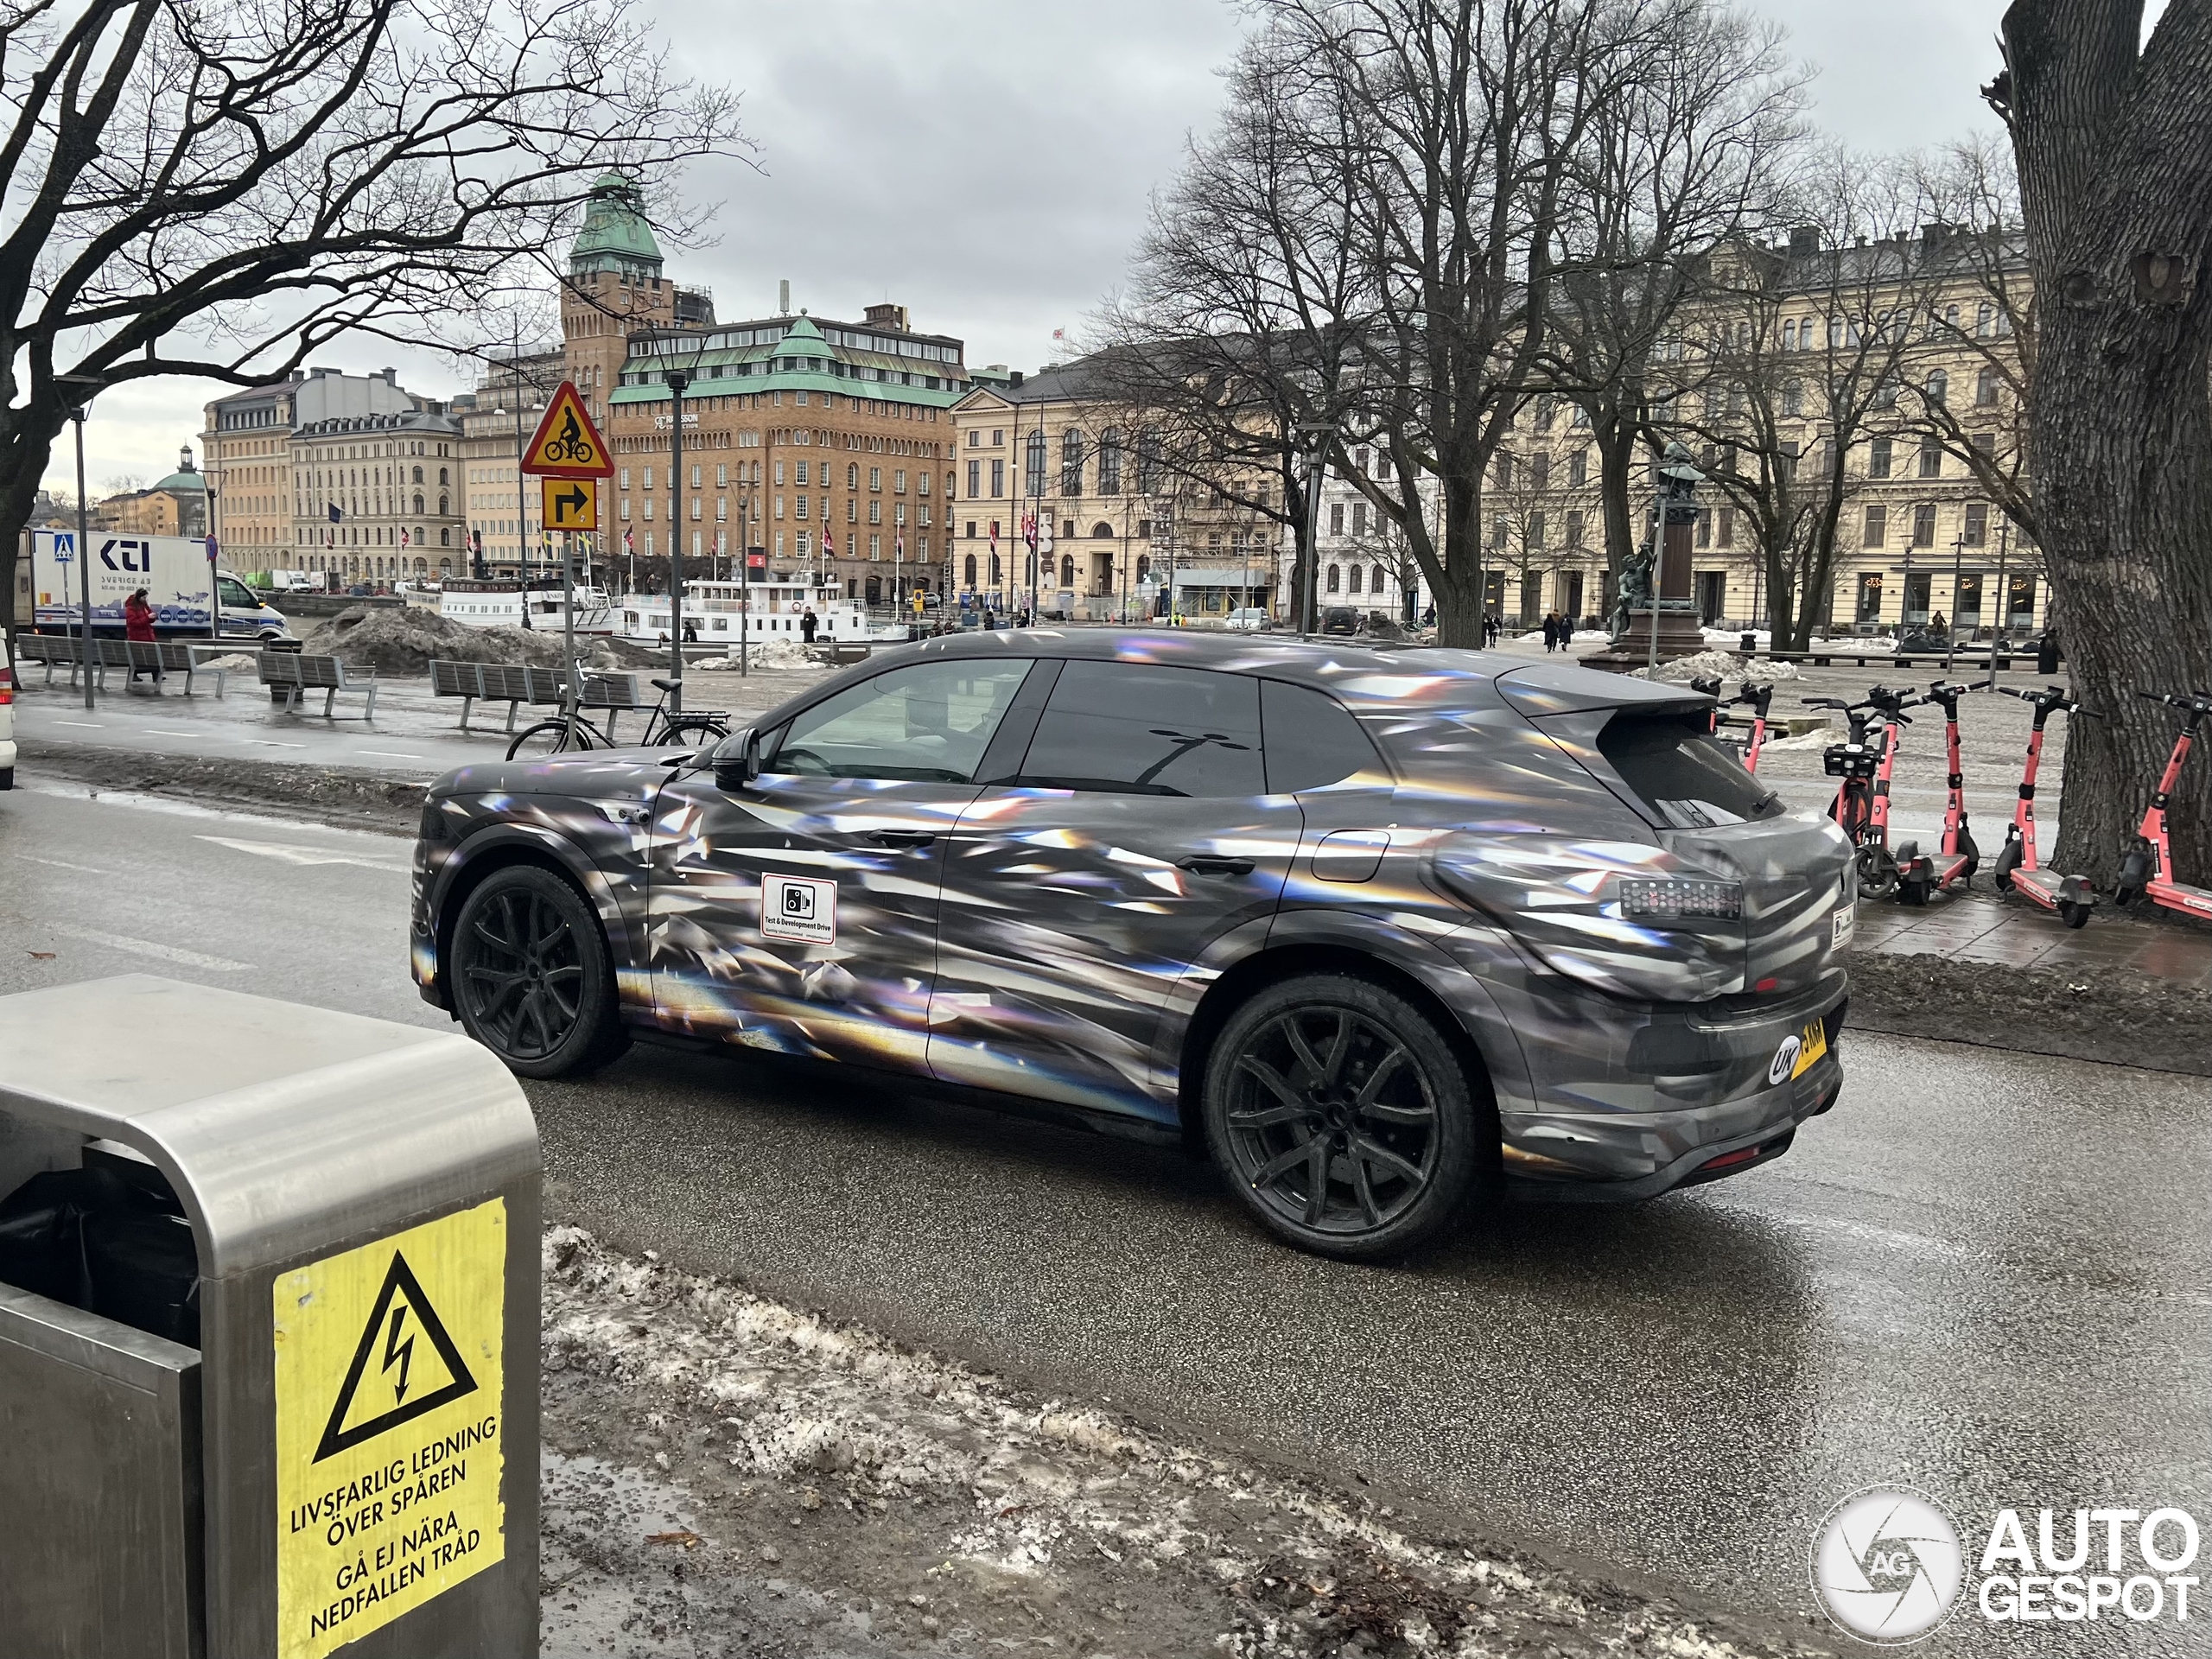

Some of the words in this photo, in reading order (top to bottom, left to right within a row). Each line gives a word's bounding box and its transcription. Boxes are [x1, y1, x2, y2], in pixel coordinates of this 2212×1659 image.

[666, 415, 698, 423] RASSON
[101, 575, 137, 585] SVERIGE
[766, 916, 776, 925] Test
[781, 918, 816, 929] Development
[817, 923, 831, 931] Drive
[1772, 1046, 1799, 1077] UK
[290, 1459, 405, 1534] LIVSFARLIG
[412, 1415, 497, 1475] LEDNING
[327, 1502, 384, 1546] ÖVER
[391, 1459, 467, 1516] SPÅREN
[336, 1549, 369, 1591] GÅ
[376, 1541, 395, 1572] EJ
[402, 1510, 459, 1558] NÄRA
[311, 1556, 425, 1638] NEDFALLEN
[432, 1529, 480, 1571] TRÅD
